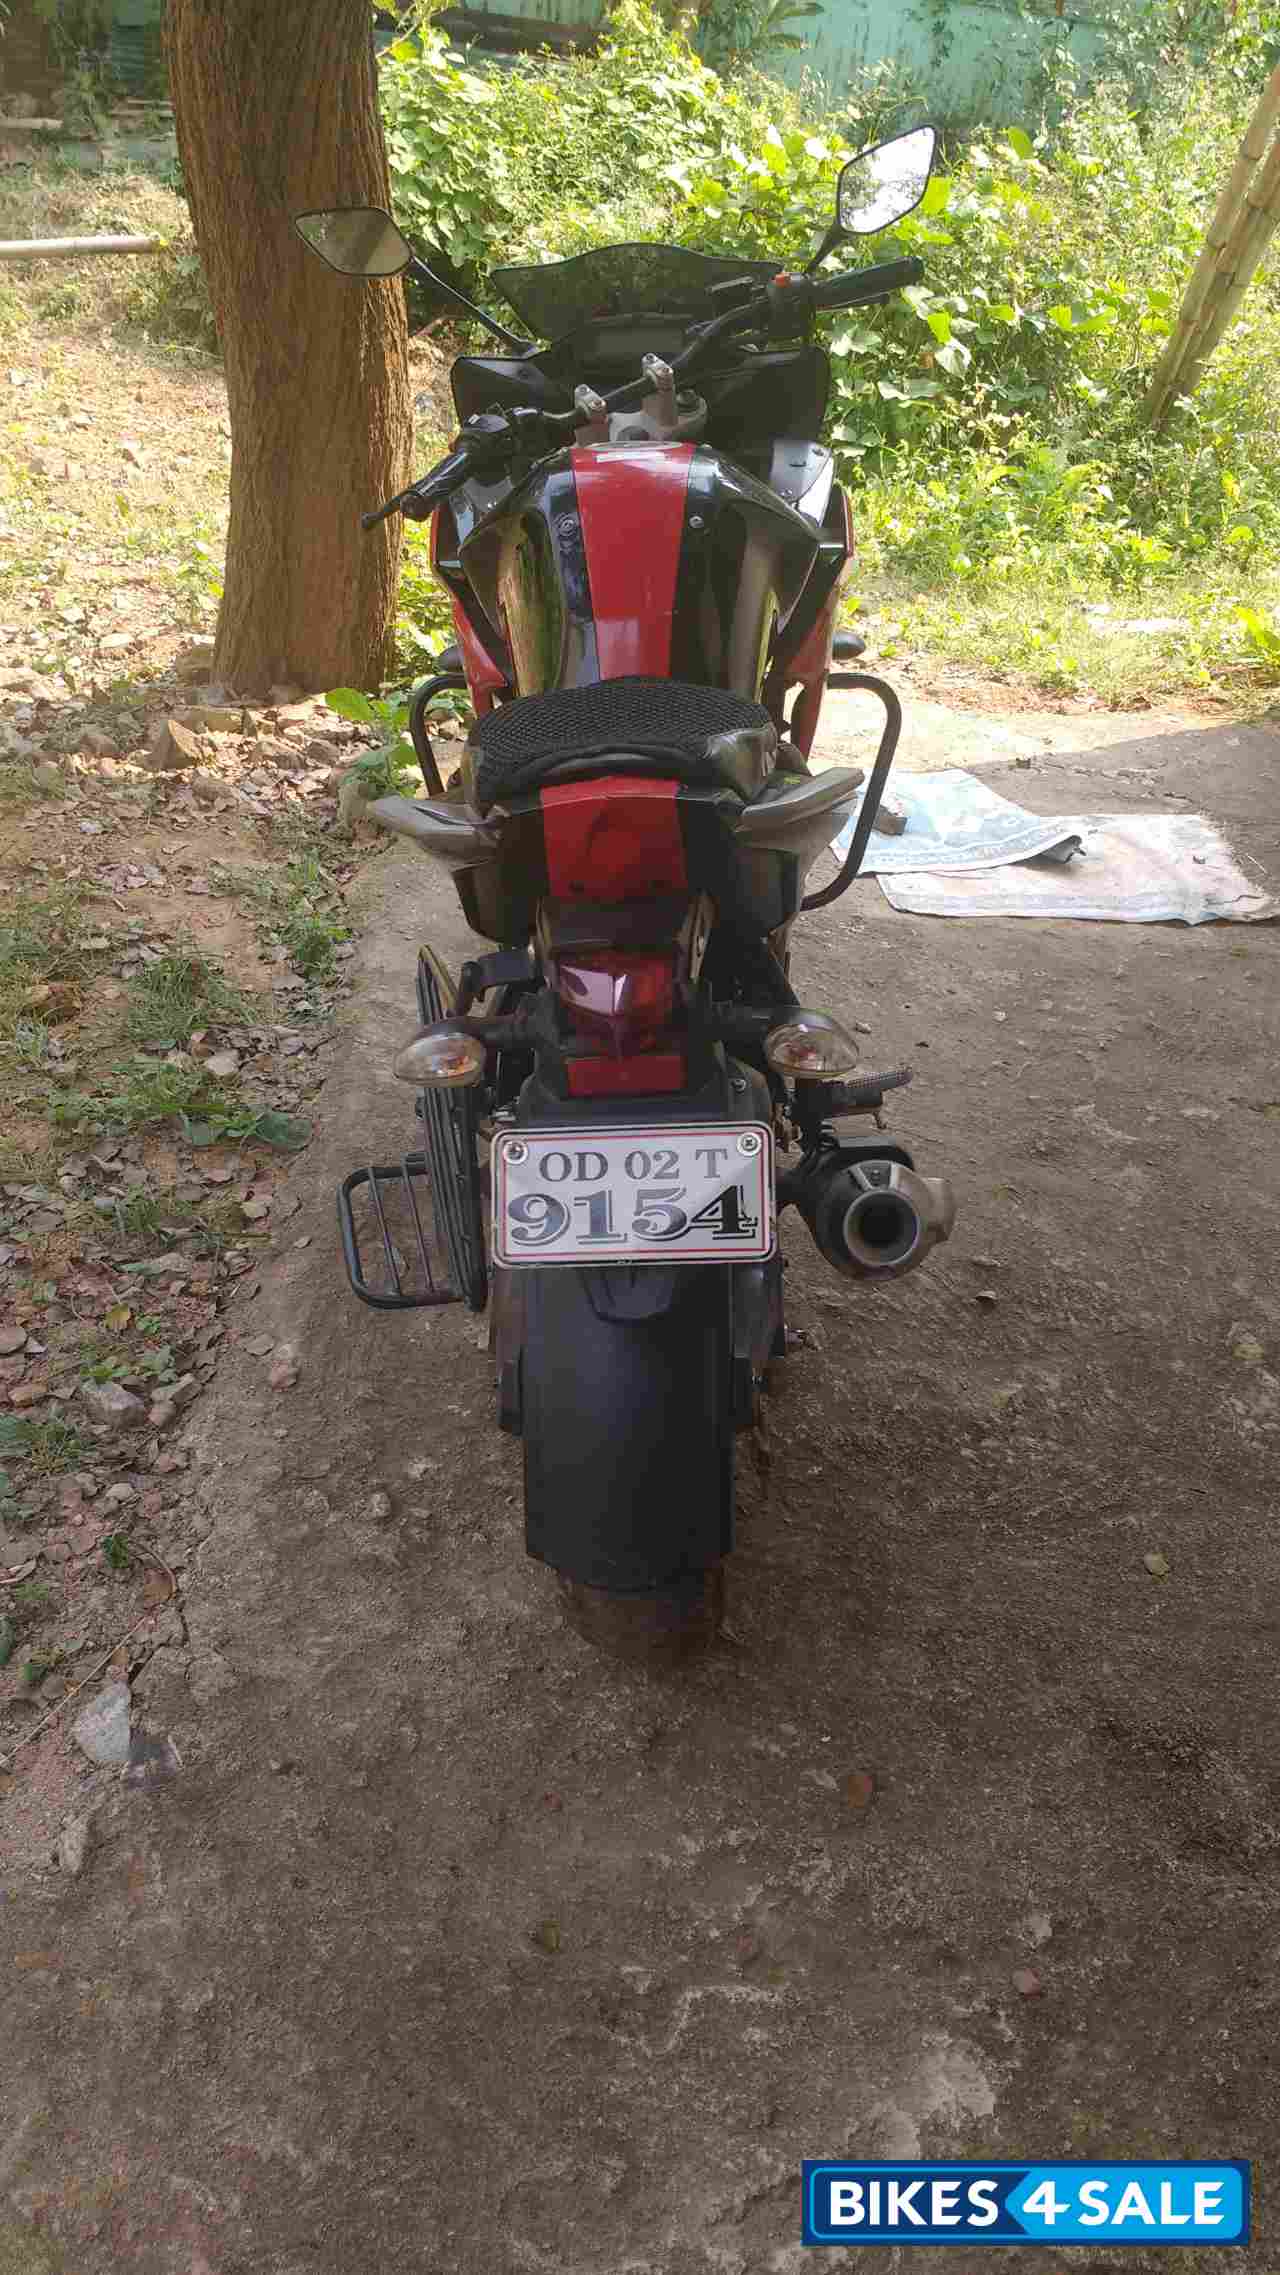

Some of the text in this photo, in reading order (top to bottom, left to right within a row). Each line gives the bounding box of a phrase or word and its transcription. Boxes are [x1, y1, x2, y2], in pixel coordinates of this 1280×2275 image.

[539, 1148, 728, 1182] OD 02 T
[507, 1184, 758, 1246] 9154
